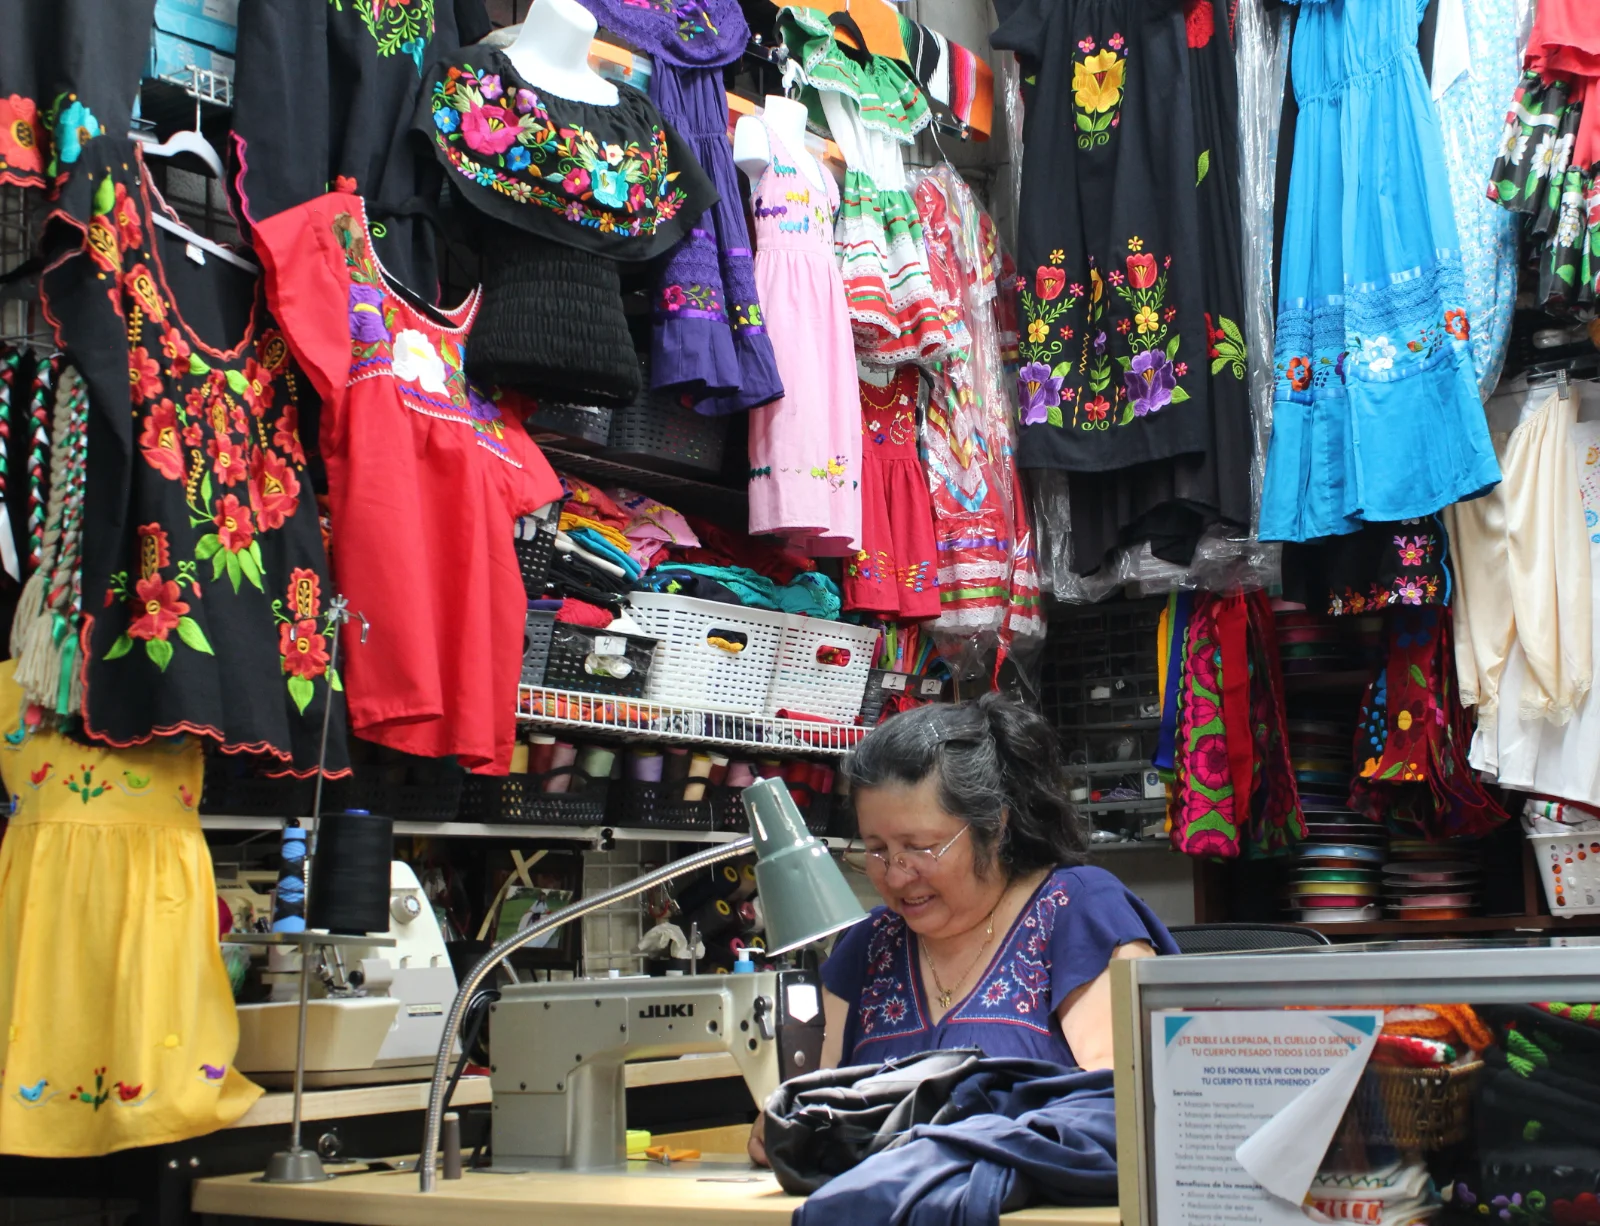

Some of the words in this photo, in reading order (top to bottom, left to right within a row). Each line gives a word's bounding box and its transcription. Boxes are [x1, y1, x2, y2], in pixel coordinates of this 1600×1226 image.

[603, 637, 612, 650] 4
[889, 676, 897, 687] 1
[926, 681, 936, 692] 2
[639, 1004, 694, 1018] JUKI
[1193, 1036, 1218, 1045] DUELE
[1219, 1036, 1231, 1045] LA
[1273, 1036, 1283, 1045] EL
[1284, 1036, 1317, 1045] CUELLO
[1319, 1036, 1326, 1045] O
[1191, 1048, 1201, 1057] TU
[1203, 1048, 1236, 1057] CUERPO
[1238, 1048, 1272, 1057] PESADO
[1274, 1048, 1303, 1057] TODOS
[1304, 1048, 1322, 1057] LOS
[1203, 1067, 1215, 1075] NO
[1217, 1067, 1226, 1075] ES
[1228, 1067, 1260, 1075] NORMAL
[1262, 1067, 1281, 1075] VIVIR
[1283, 1067, 1302, 1075] CON
[1201, 1078, 1211, 1086] TU
[1212, 1078, 1243, 1086] CUERPO
[1244, 1078, 1253, 1086] TE
[1254, 1076, 1272, 1086] ESTÁ
[1274, 1078, 1311, 1087] PIDIENDO
